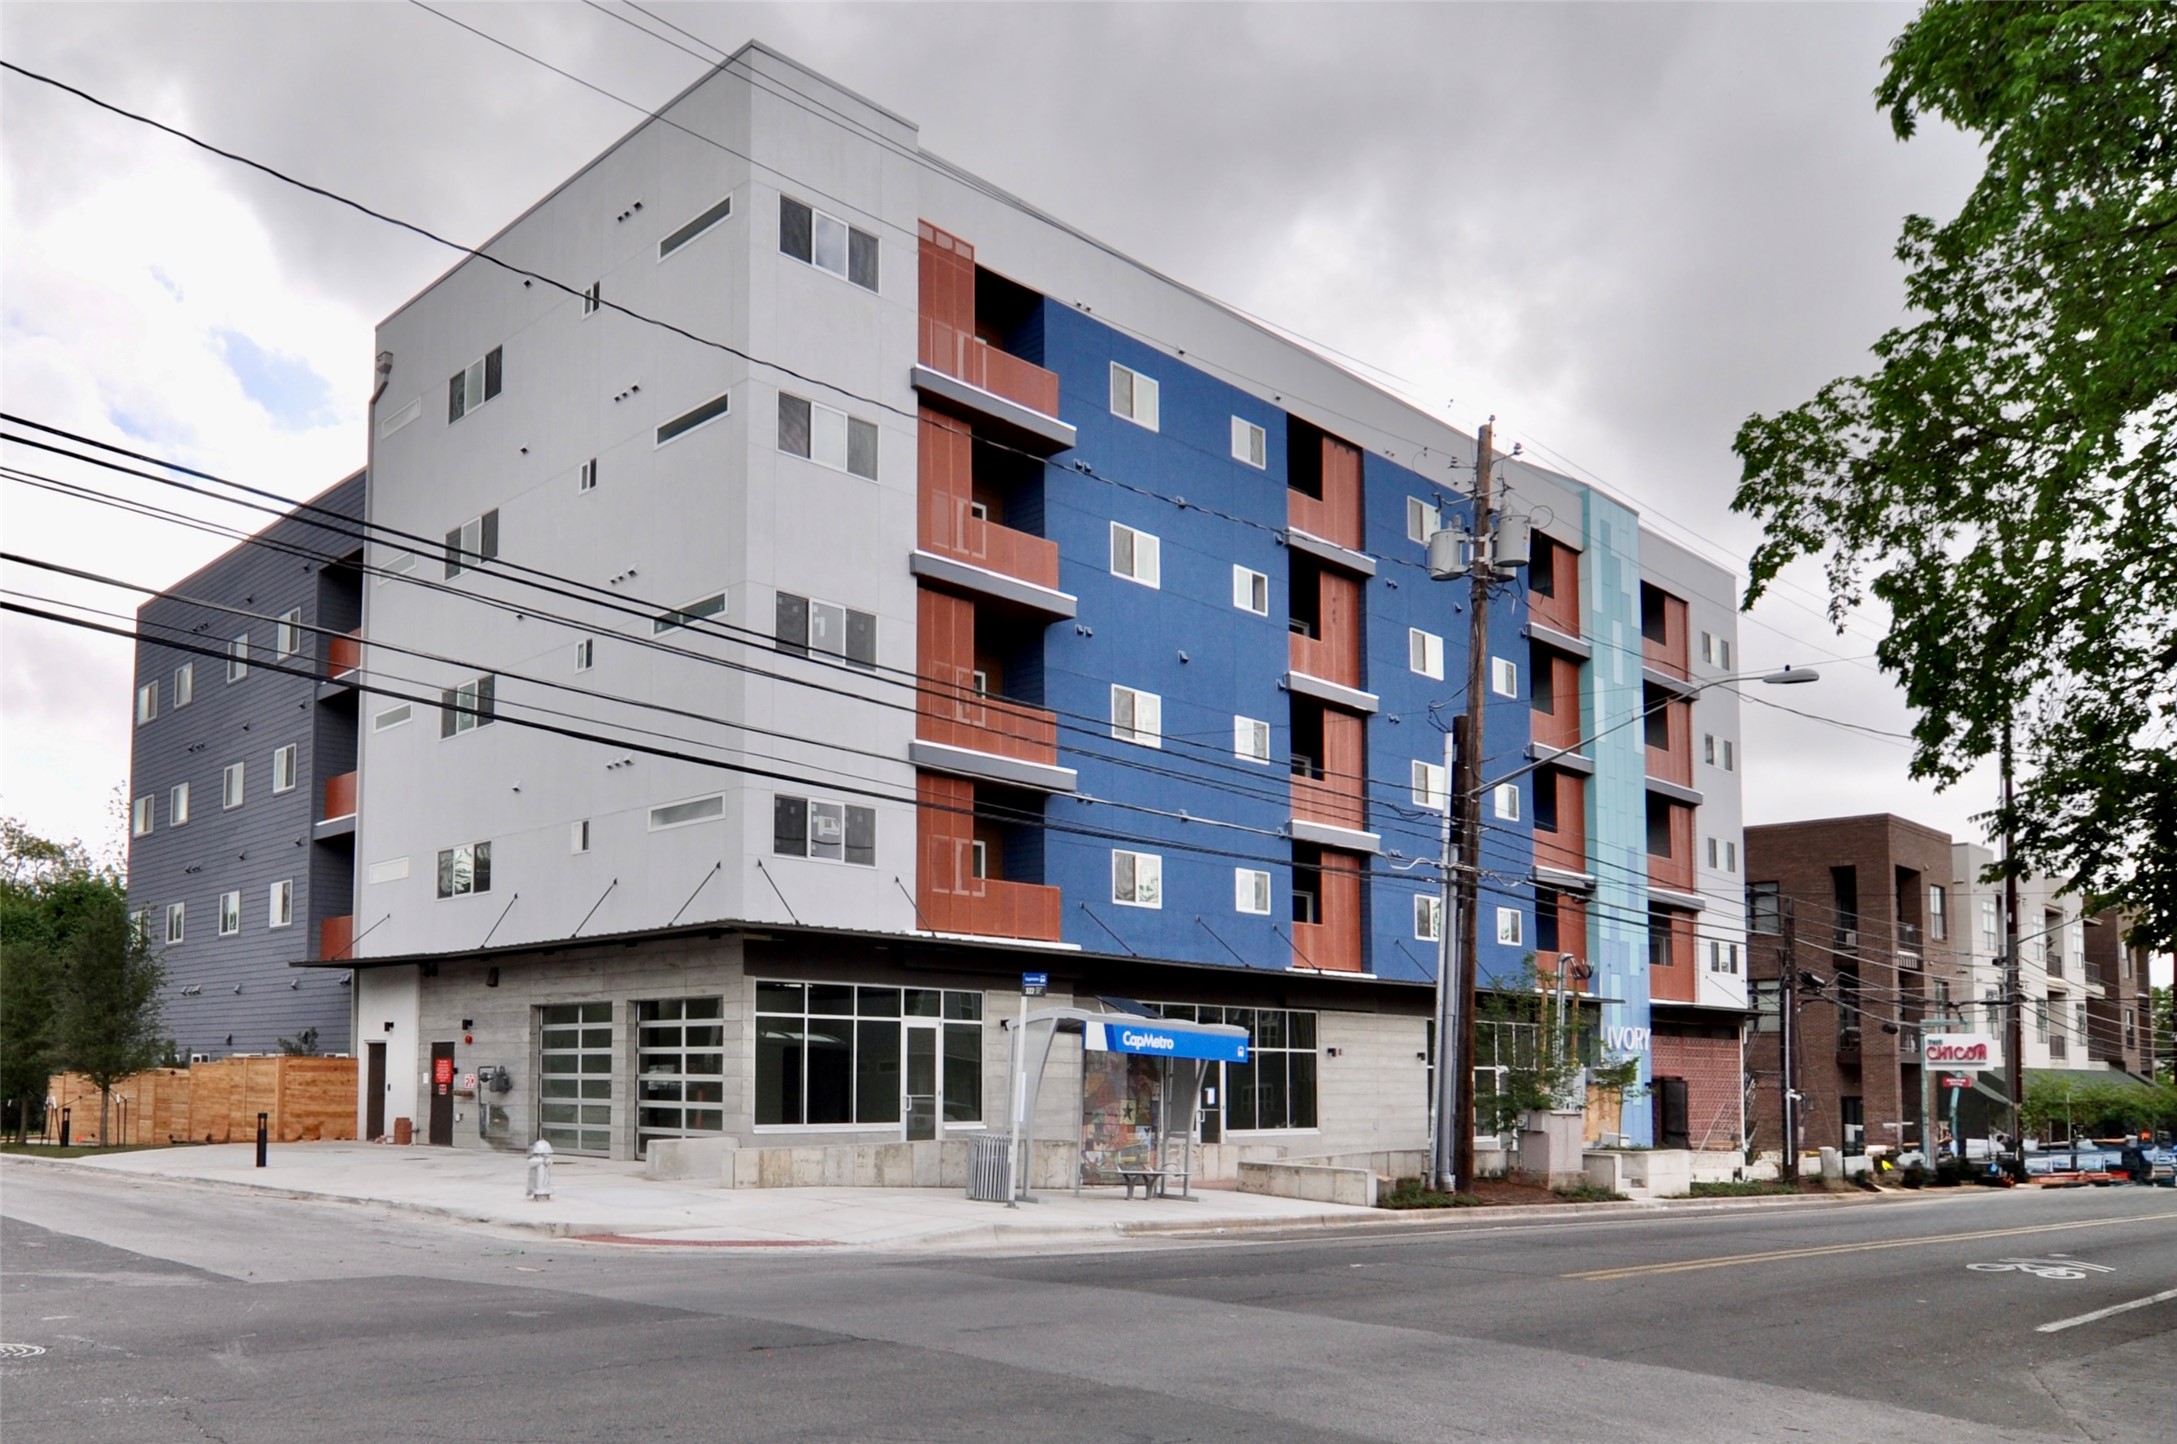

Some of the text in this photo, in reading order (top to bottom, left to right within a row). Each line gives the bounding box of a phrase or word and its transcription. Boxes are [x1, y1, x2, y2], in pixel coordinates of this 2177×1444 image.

[1122, 1031, 1174, 1050] CapMetro
[1608, 1025, 1651, 1050] IVORY
[1926, 1043, 1987, 1060] CHICON
